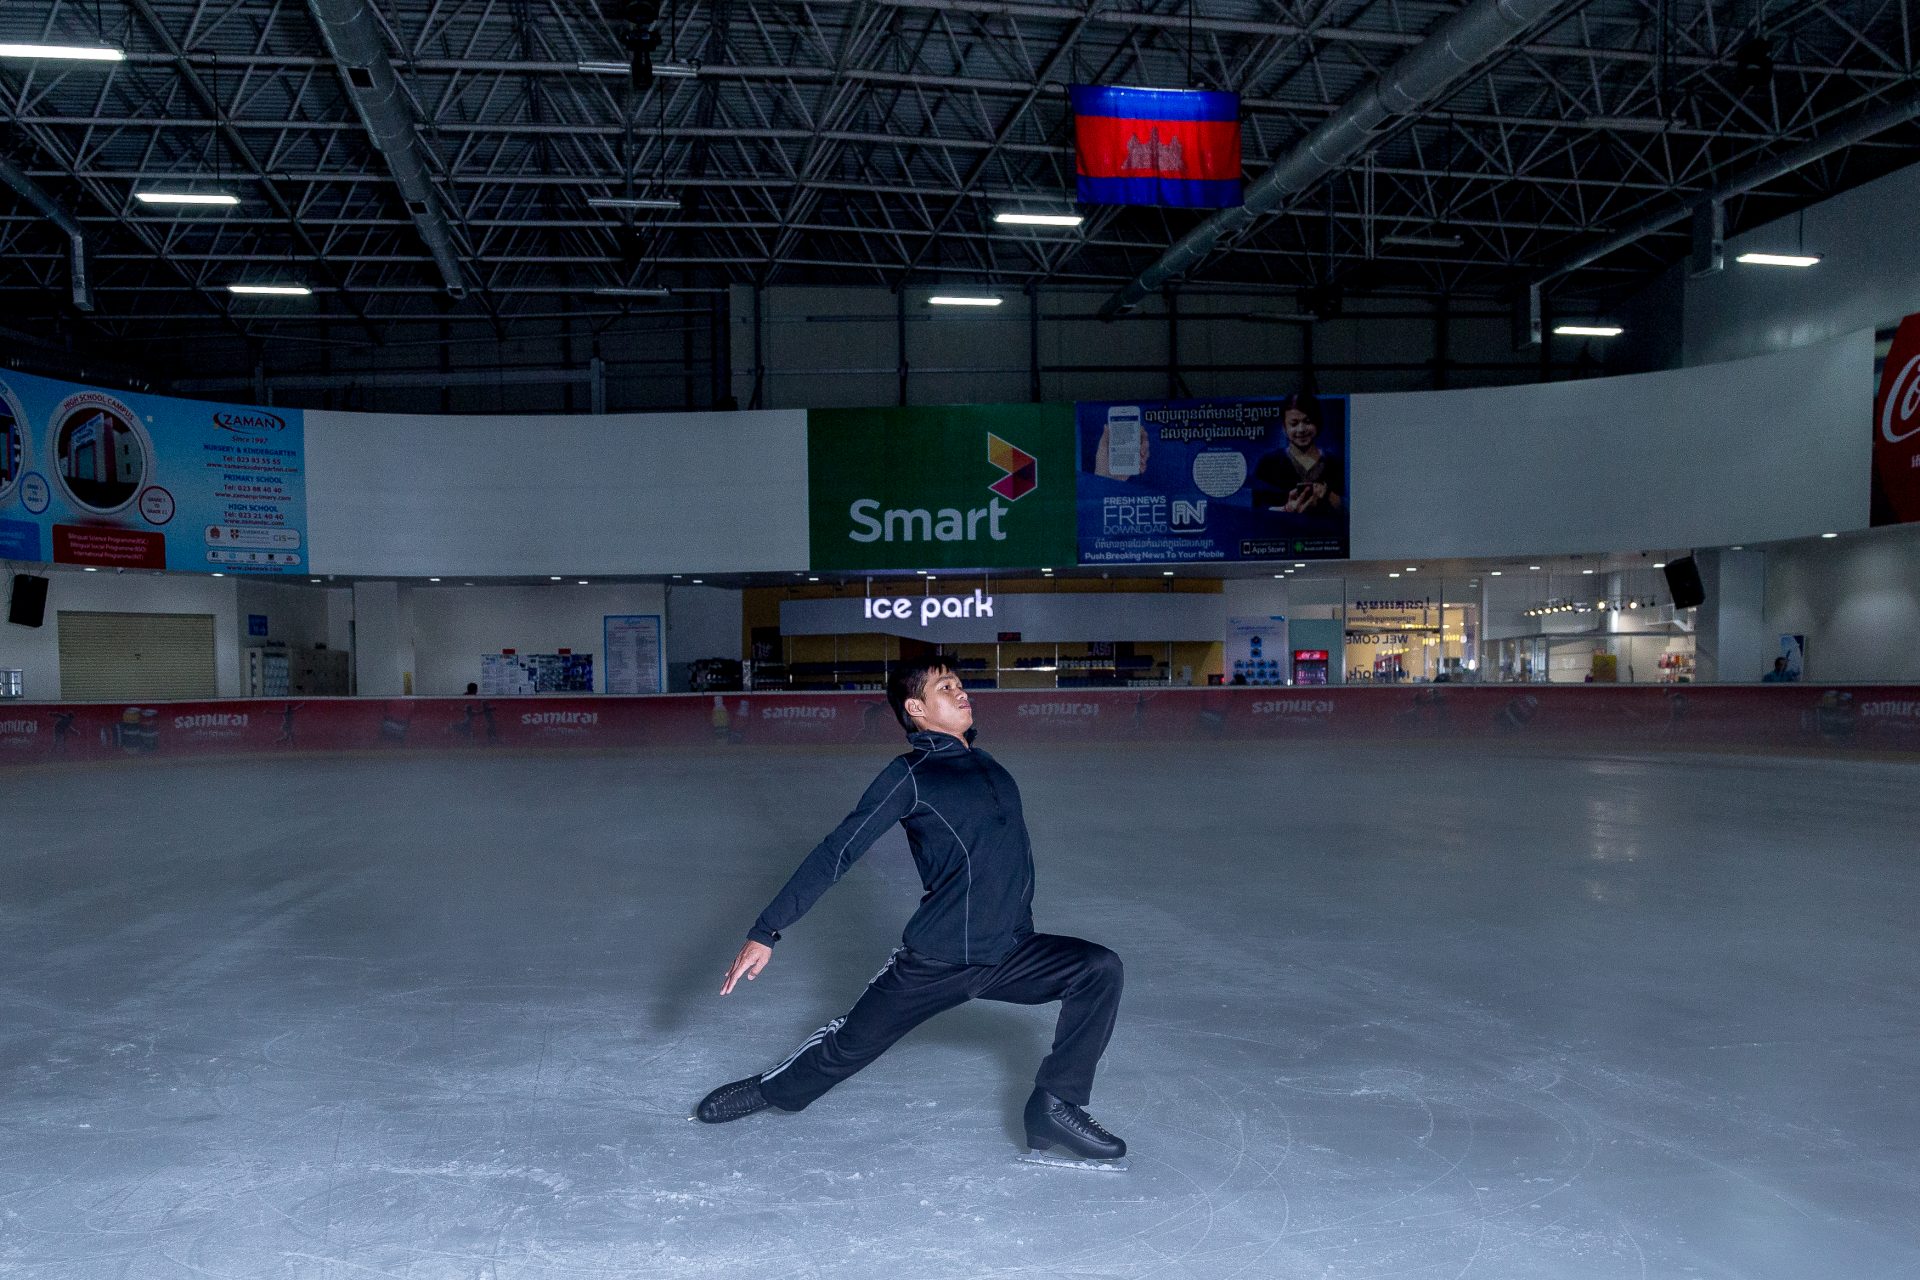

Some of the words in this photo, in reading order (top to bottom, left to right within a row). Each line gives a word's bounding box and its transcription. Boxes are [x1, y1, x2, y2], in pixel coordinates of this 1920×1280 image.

[64, 396, 79, 410] HIGH
[79, 394, 106, 403] SCHOOL
[107, 398, 134, 420] CAMPUS
[223, 414, 275, 429] ZAMAN
[203, 444, 234, 453] NURSERY
[243, 448, 297, 457] KINDERGARTEN
[223, 473, 254, 483] PRIMARY
[255, 475, 283, 484] SCHOOL
[1103, 496, 1136, 505] FRESH
[1137, 495, 1166, 504] NEWS
[228, 503, 248, 511] HIGH
[249, 504, 278, 513] SCHOOL
[849, 497, 1008, 543] Smart
[1103, 505, 1167, 526] FREE
[1103, 524, 1168, 535] DOWNLOAD
[1106, 551, 1141, 562] Breaking
[1142, 551, 1165, 560] News
[1166, 551, 1177, 559] To
[1177, 550, 1198, 559] Your
[1198, 549, 1225, 558] Mobile
[1251, 546, 1267, 555] App
[864, 597, 912, 619] ice
[920, 589, 994, 626] park
[762, 705, 837, 719] samurai
[1018, 702, 1099, 717] samurai
[1253, 699, 1334, 714] samurai
[174, 713, 249, 729] samurai
[522, 711, 598, 725] samurai
